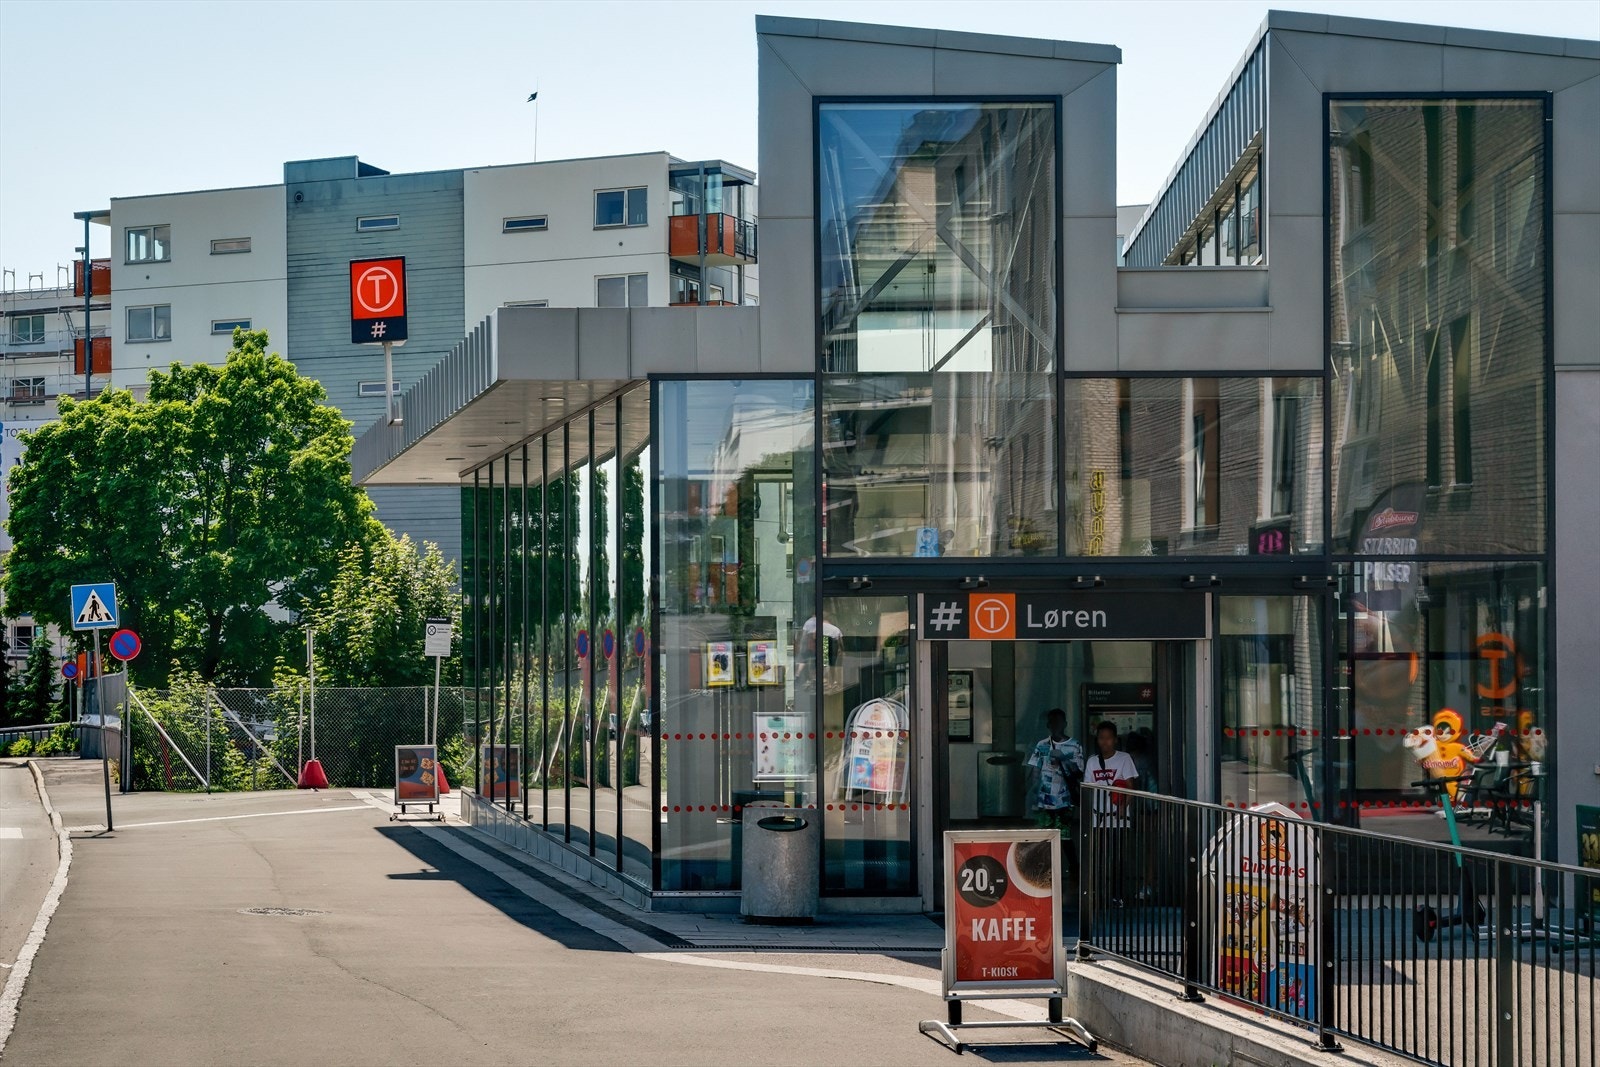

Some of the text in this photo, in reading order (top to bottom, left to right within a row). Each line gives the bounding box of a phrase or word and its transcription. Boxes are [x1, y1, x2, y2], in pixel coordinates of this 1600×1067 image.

[367, 274, 387, 304] T
[983, 606, 1001, 629] T
[1027, 604, 1107, 629] Løren
[961, 868, 1004, 895] 20,-
[971, 917, 1036, 942] KAFFE
[982, 966, 1018, 977] T-KIOSK
